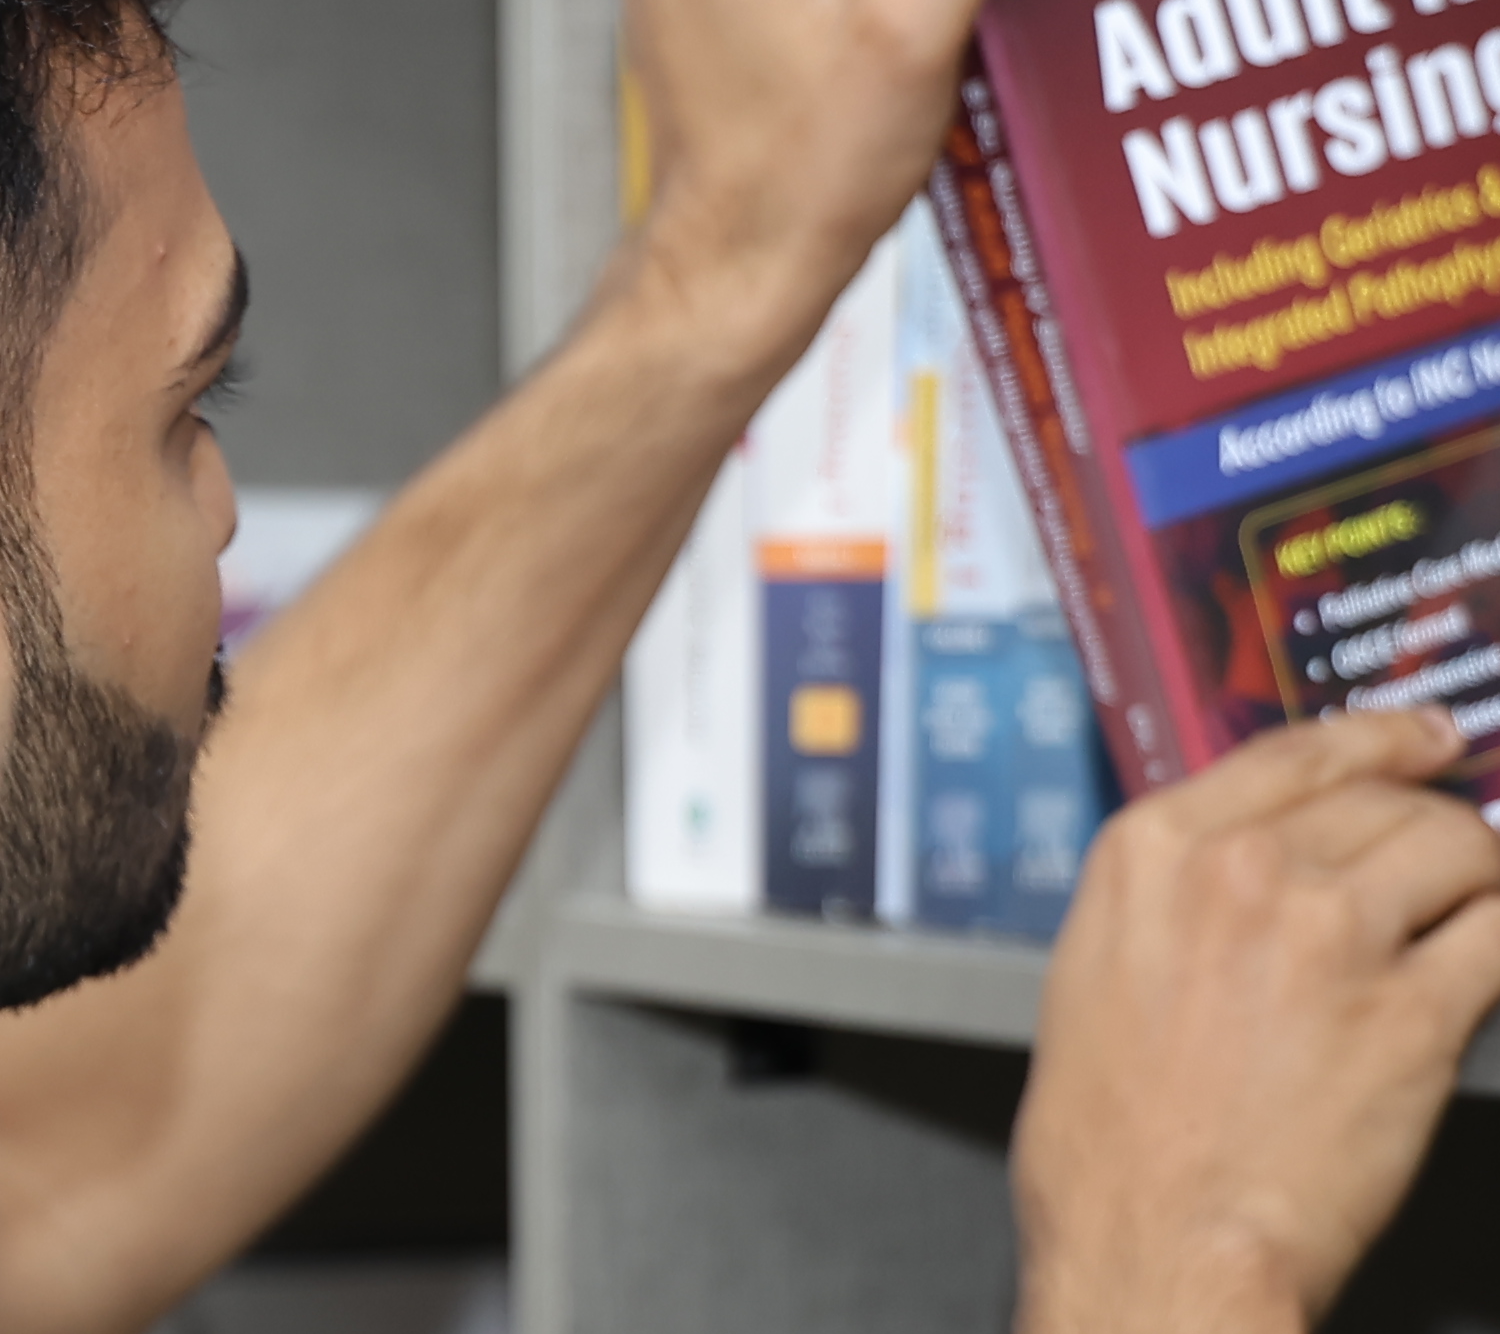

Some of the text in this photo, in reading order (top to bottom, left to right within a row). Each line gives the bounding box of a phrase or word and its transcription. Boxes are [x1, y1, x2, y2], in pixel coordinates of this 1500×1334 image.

[1165, 236, 1327, 319] Including
[1184, 284, 1352, 379] Integrated
[1219, 389, 1382, 475] According
[1375, 374, 1412, 420] to
